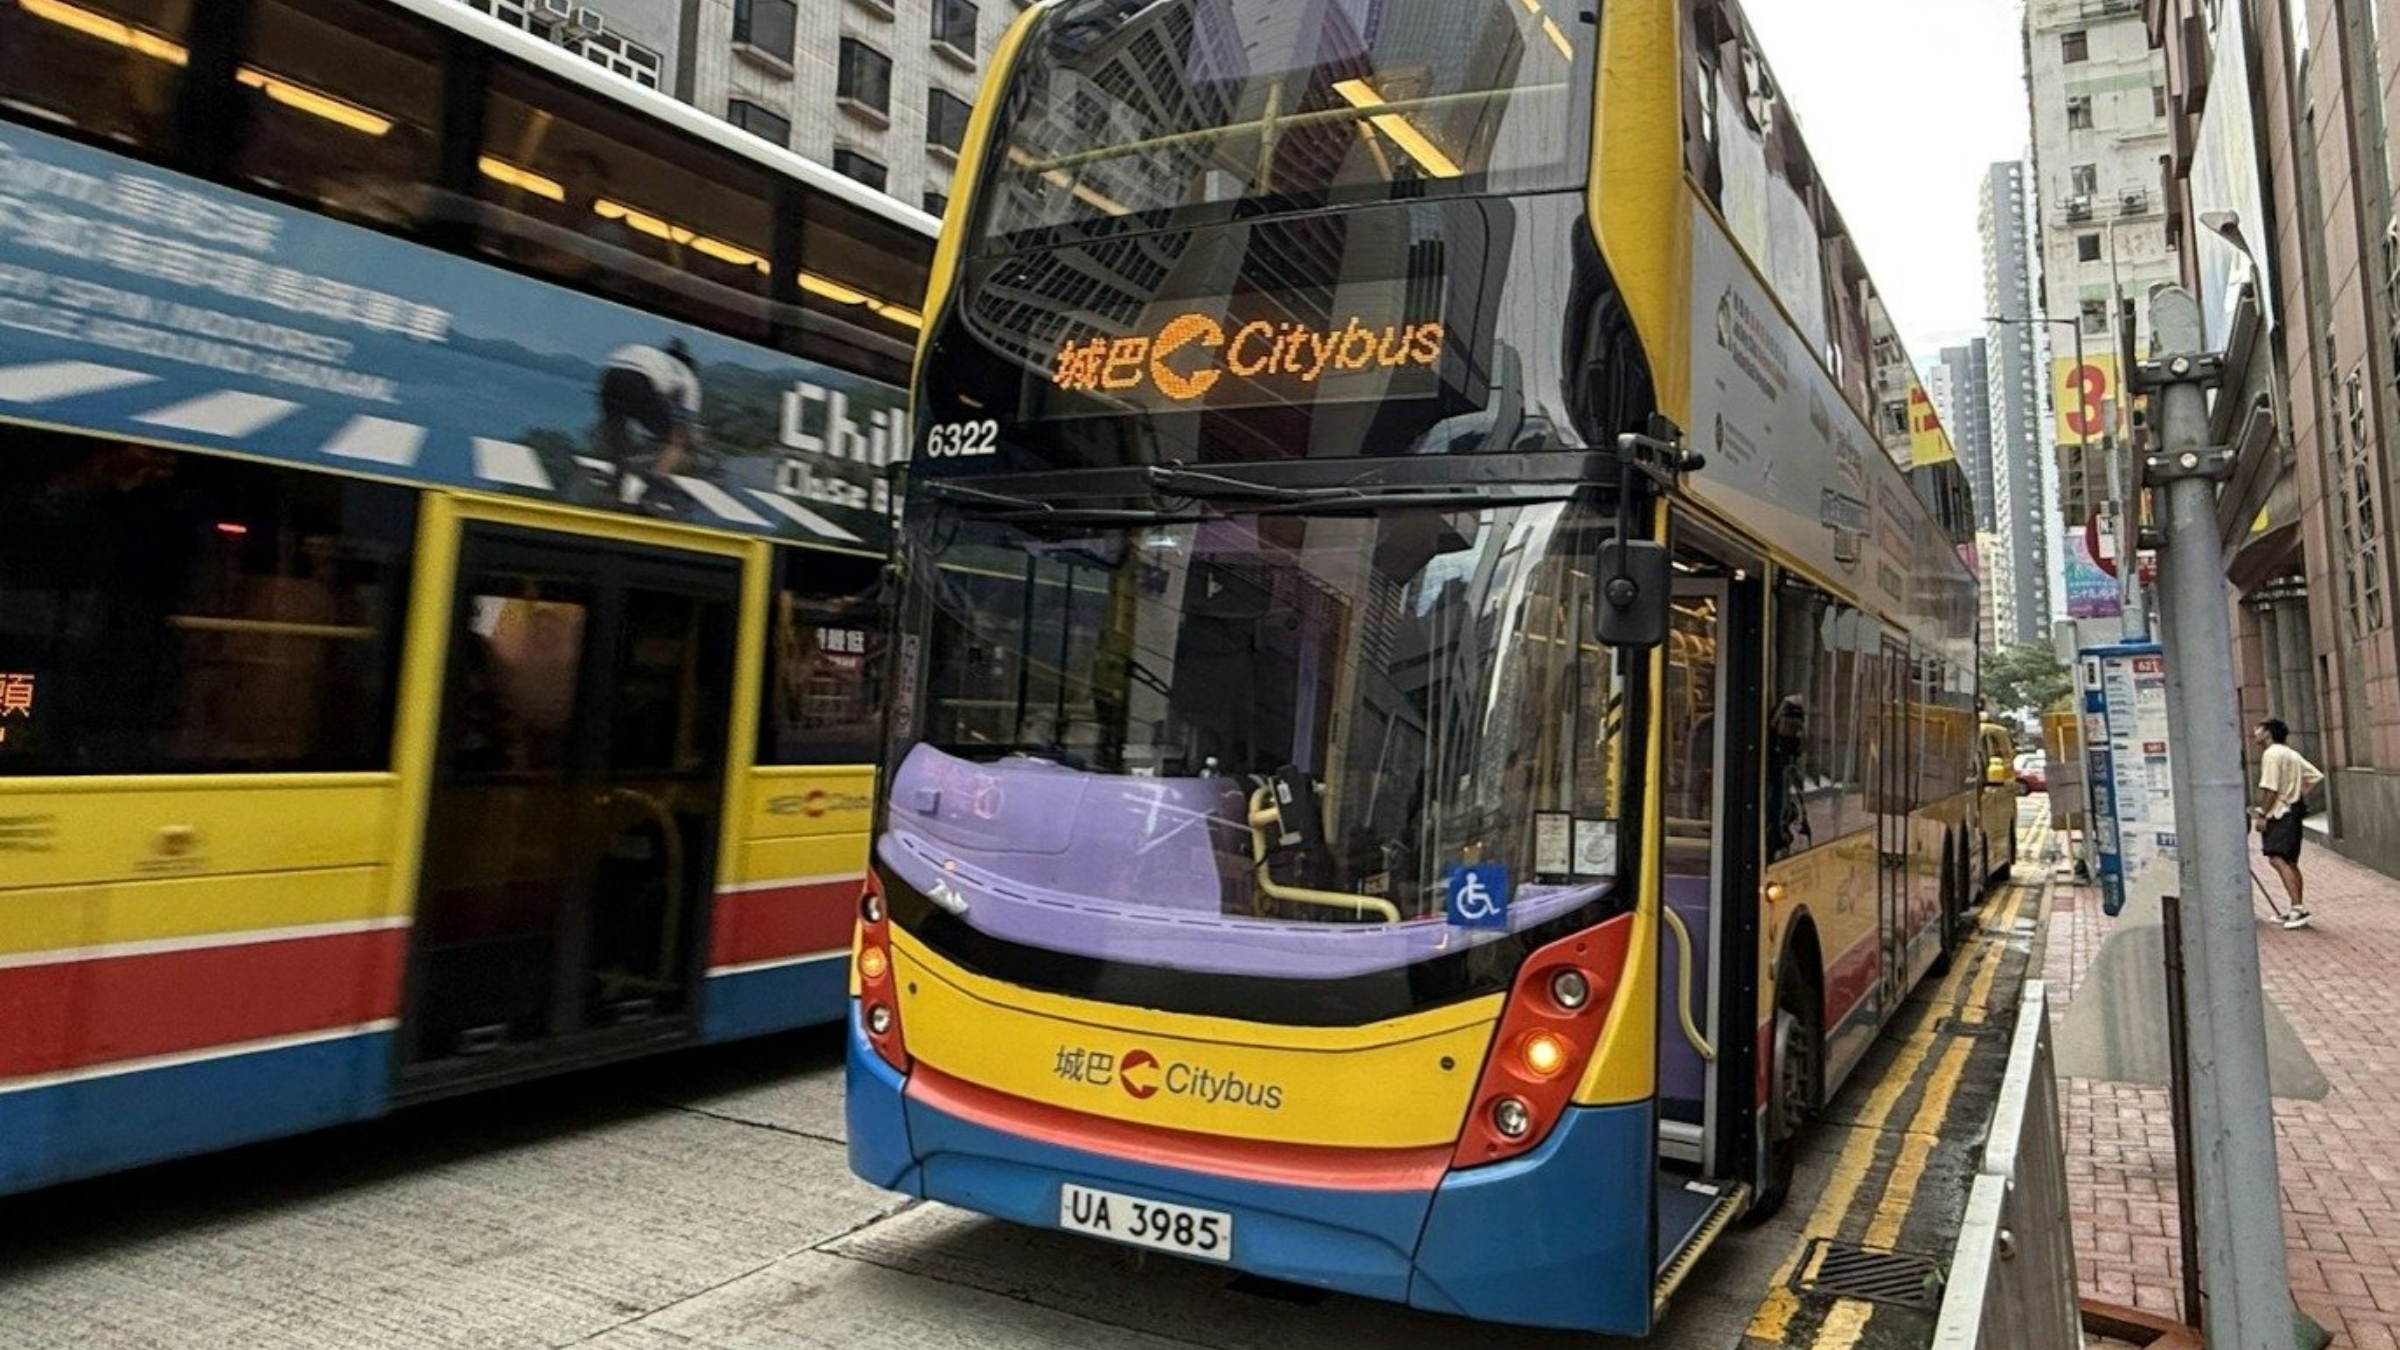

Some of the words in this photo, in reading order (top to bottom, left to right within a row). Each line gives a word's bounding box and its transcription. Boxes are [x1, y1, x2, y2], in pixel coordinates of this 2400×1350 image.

[1052, 336, 1149, 390] 城巴
[1226, 316, 1445, 382] Citybus
[2065, 364, 2107, 435] 3
[927, 419, 999, 458] 6322
[1054, 1045, 1115, 1086] 城巴
[1165, 1062, 1283, 1110] Citybus
[1071, 1190, 1111, 1231] UA
[1127, 1203, 1219, 1251] 3985
